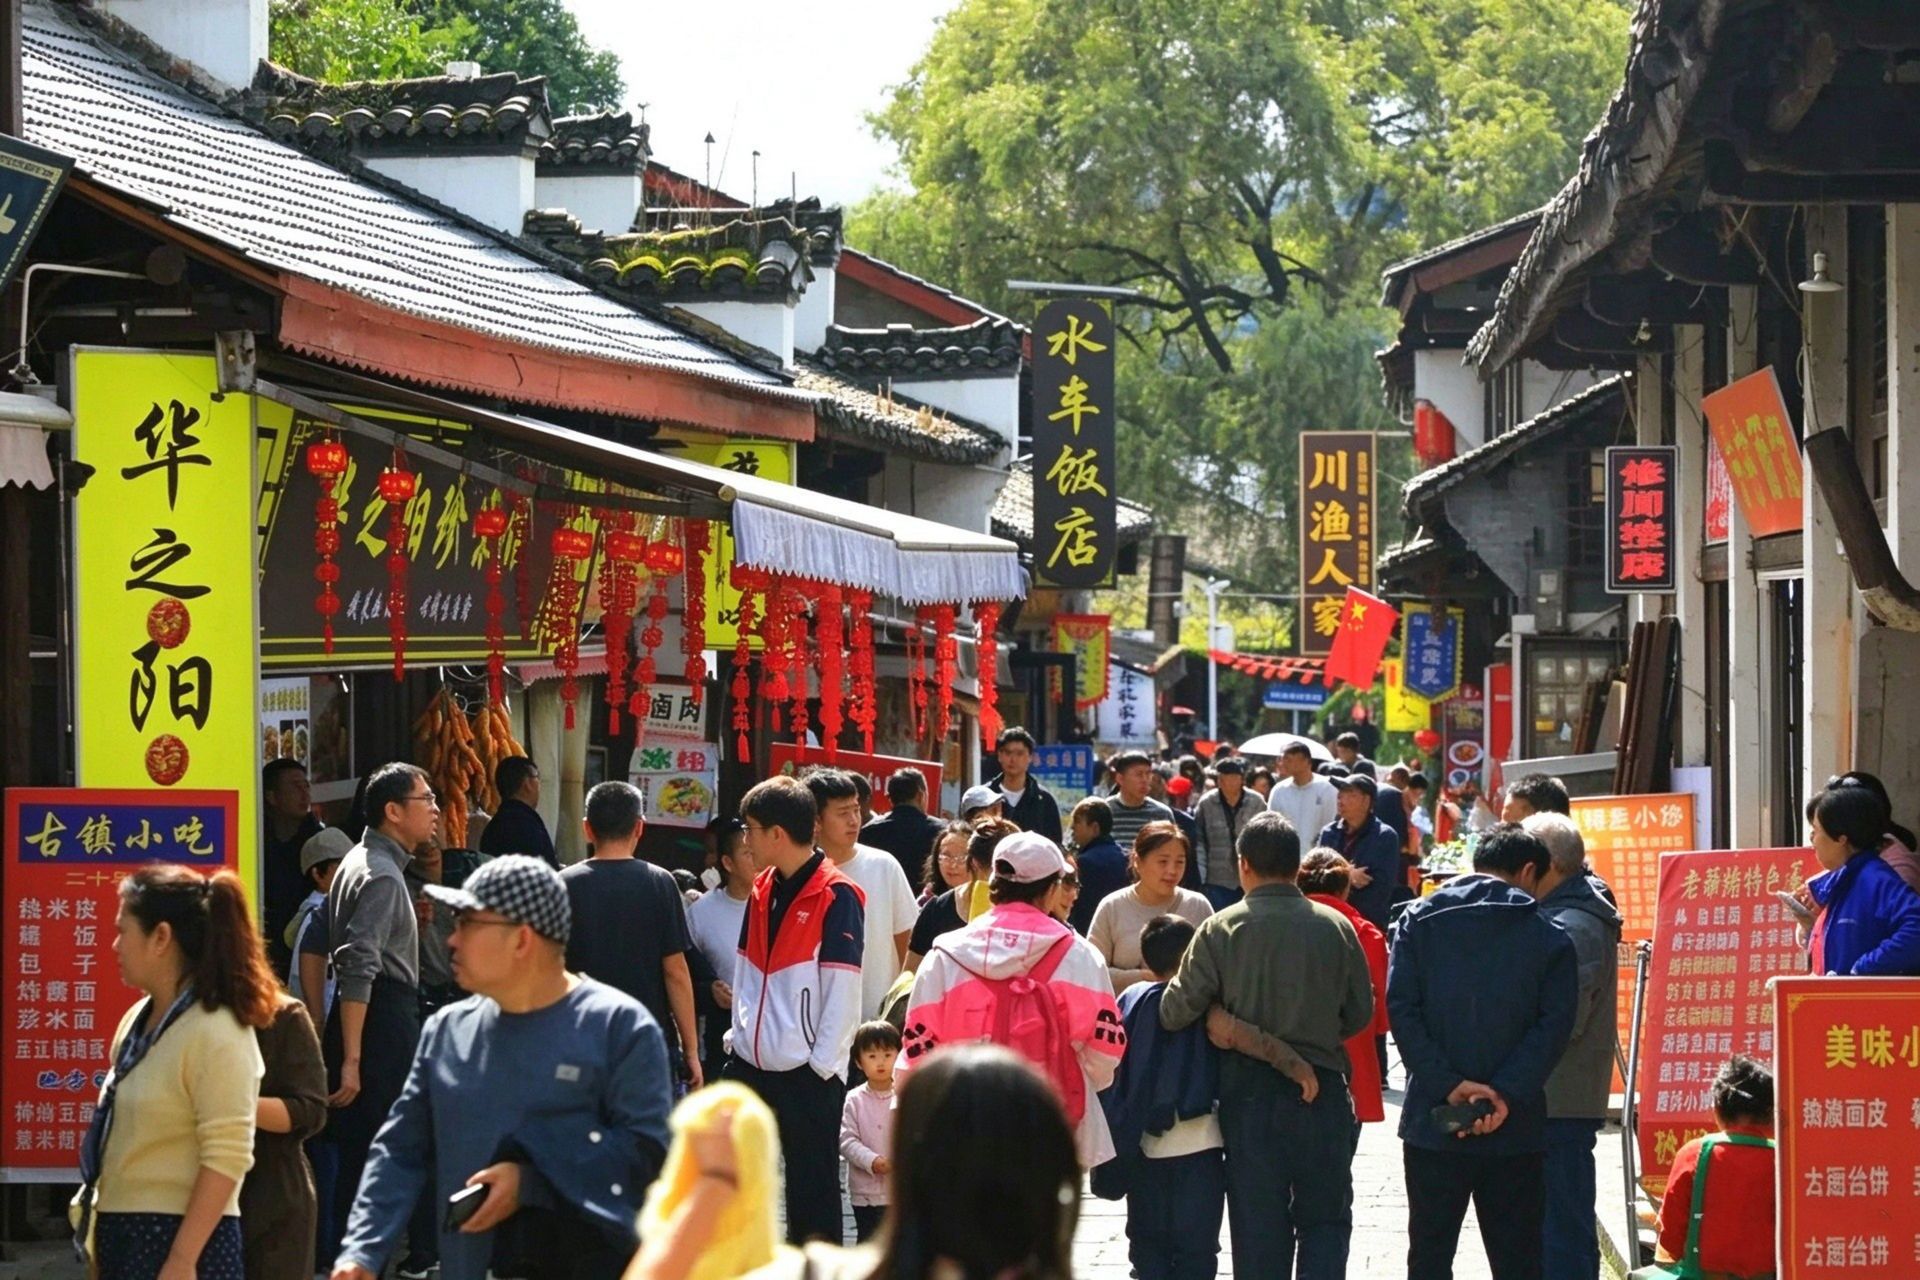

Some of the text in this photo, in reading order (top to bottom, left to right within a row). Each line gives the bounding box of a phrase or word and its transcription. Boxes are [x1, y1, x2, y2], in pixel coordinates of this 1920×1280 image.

[1047, 314, 1107, 568] 水车饭店
[121, 399, 213, 733] 华之阳
[1308, 450, 1354, 637] 川渔人家
[651, 693, 700, 723] 卤肉
[25, 811, 214, 857] 古镇小吃
